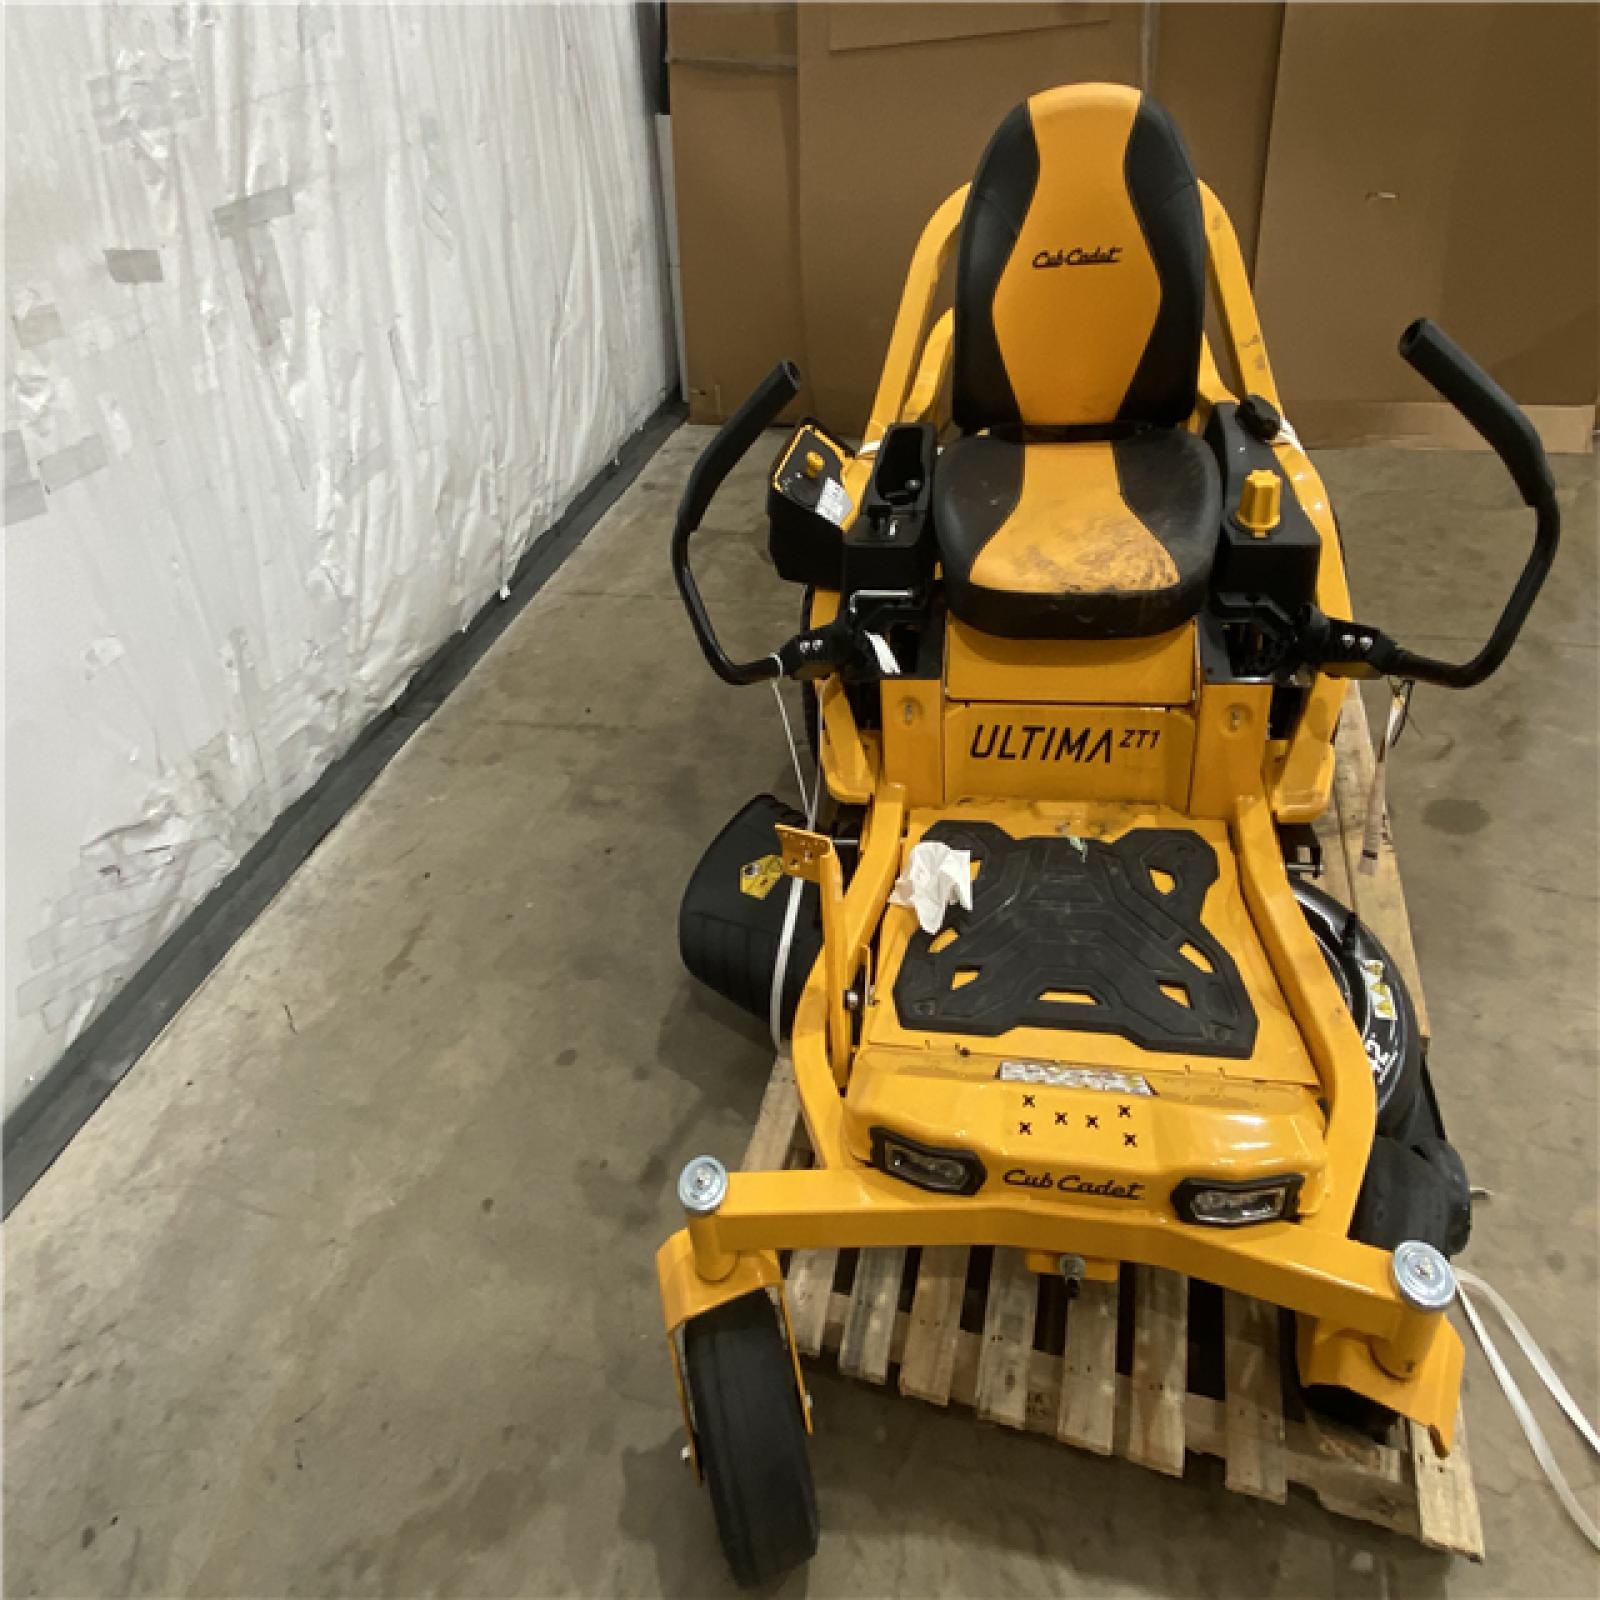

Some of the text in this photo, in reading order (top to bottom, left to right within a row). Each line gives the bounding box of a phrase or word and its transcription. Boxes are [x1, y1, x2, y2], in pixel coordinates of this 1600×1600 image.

[1032, 246, 1122, 269] Cub Cadet
[970, 724, 1161, 763] ULTIMA ZT1
[1002, 1168, 1145, 1201] Cub Cadet
